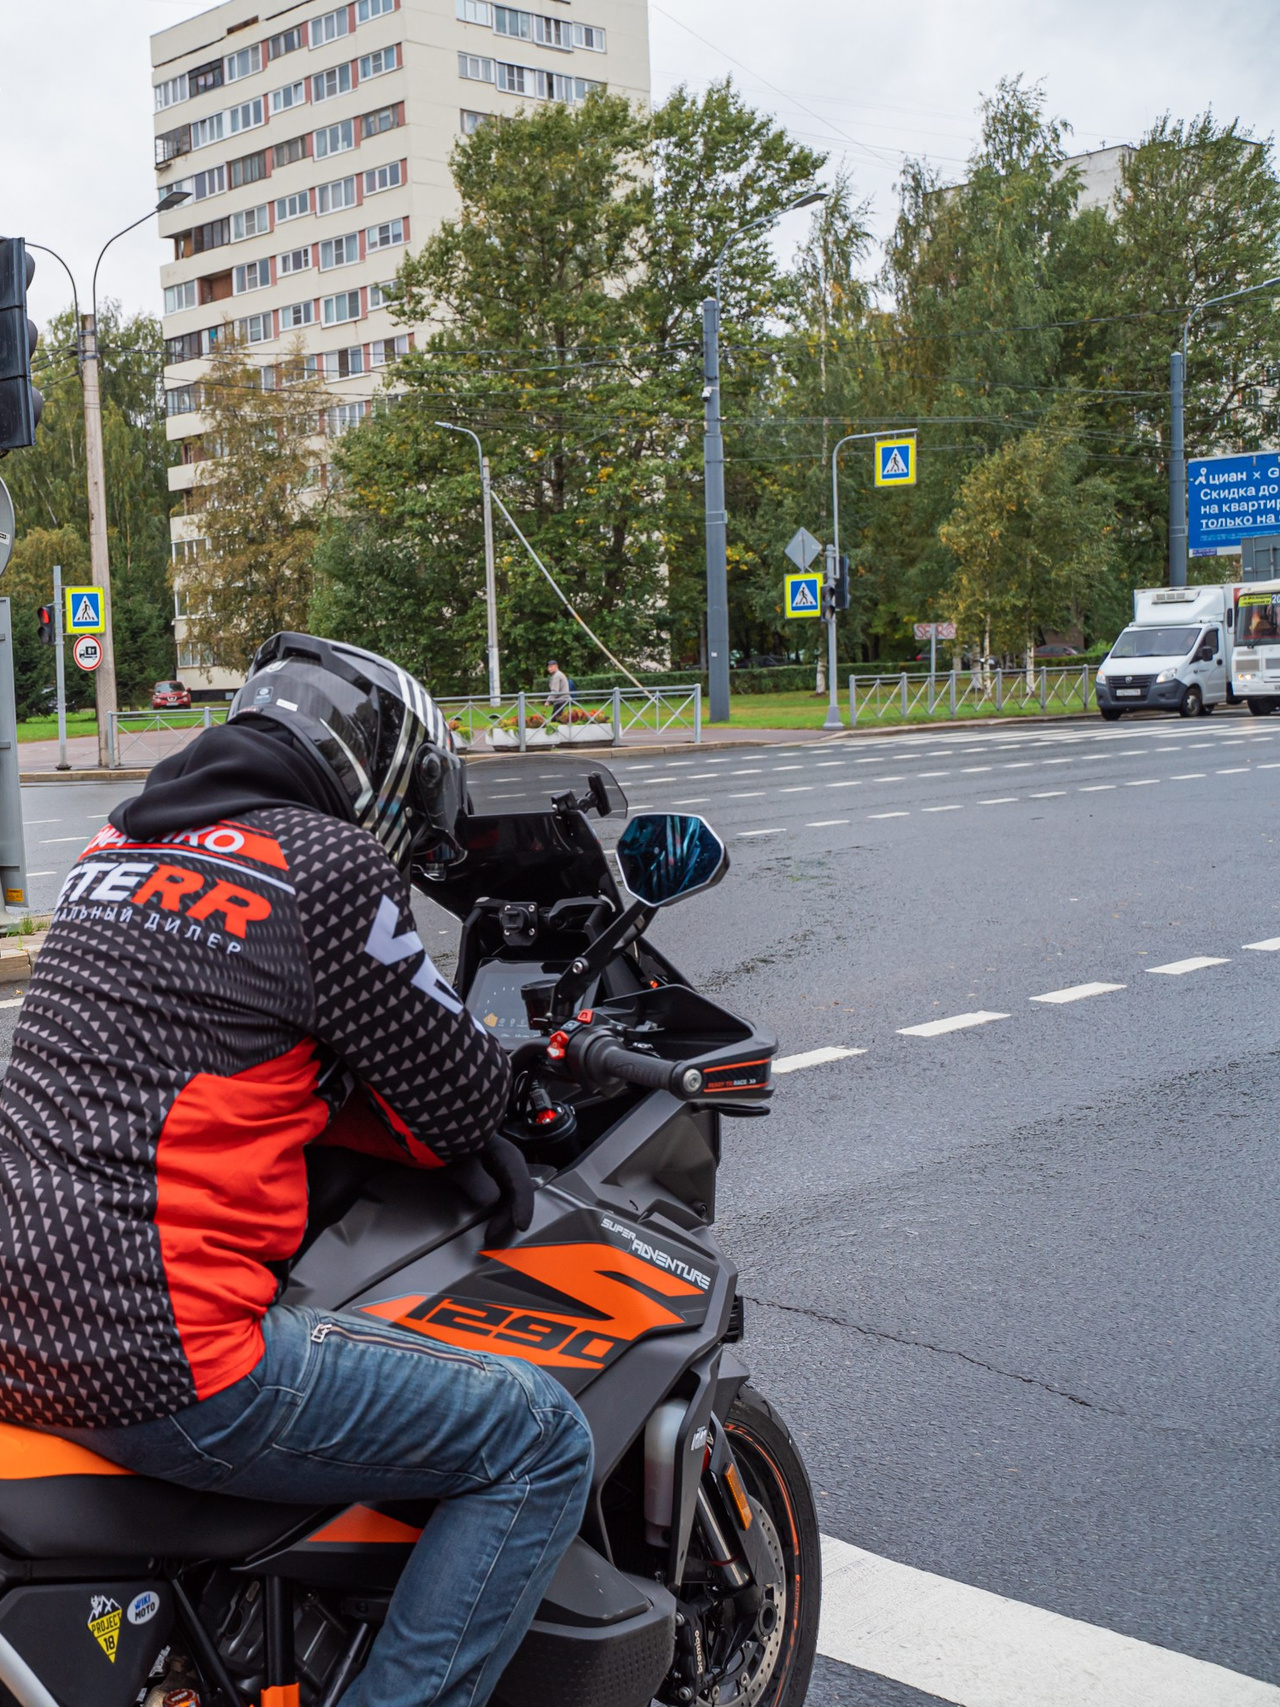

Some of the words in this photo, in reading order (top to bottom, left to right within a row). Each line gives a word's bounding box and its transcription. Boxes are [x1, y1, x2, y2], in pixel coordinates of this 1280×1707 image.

[1209, 472, 1246, 485] циан
[1200, 486, 1256, 500] Скидка
[1259, 484, 1278, 497] до
[1201, 504, 1219, 515] на
[1200, 516, 1253, 529] только
[1257, 513, 1275, 525] на
[54, 862, 272, 940] ETERR
[144, 911, 242, 955] ДИЛЕР
[600, 1217, 637, 1240] SUPER
[631, 1239, 711, 1290] ADVENTURE
[406, 1298, 627, 1362] 1290
[134, 1594, 152, 1611] WIKI
[134, 1602, 156, 1622] MOTO
[91, 1612, 121, 1635] PROJECT
[104, 1635, 116, 1652] 18
[694, 1630, 703, 1675] brembo
